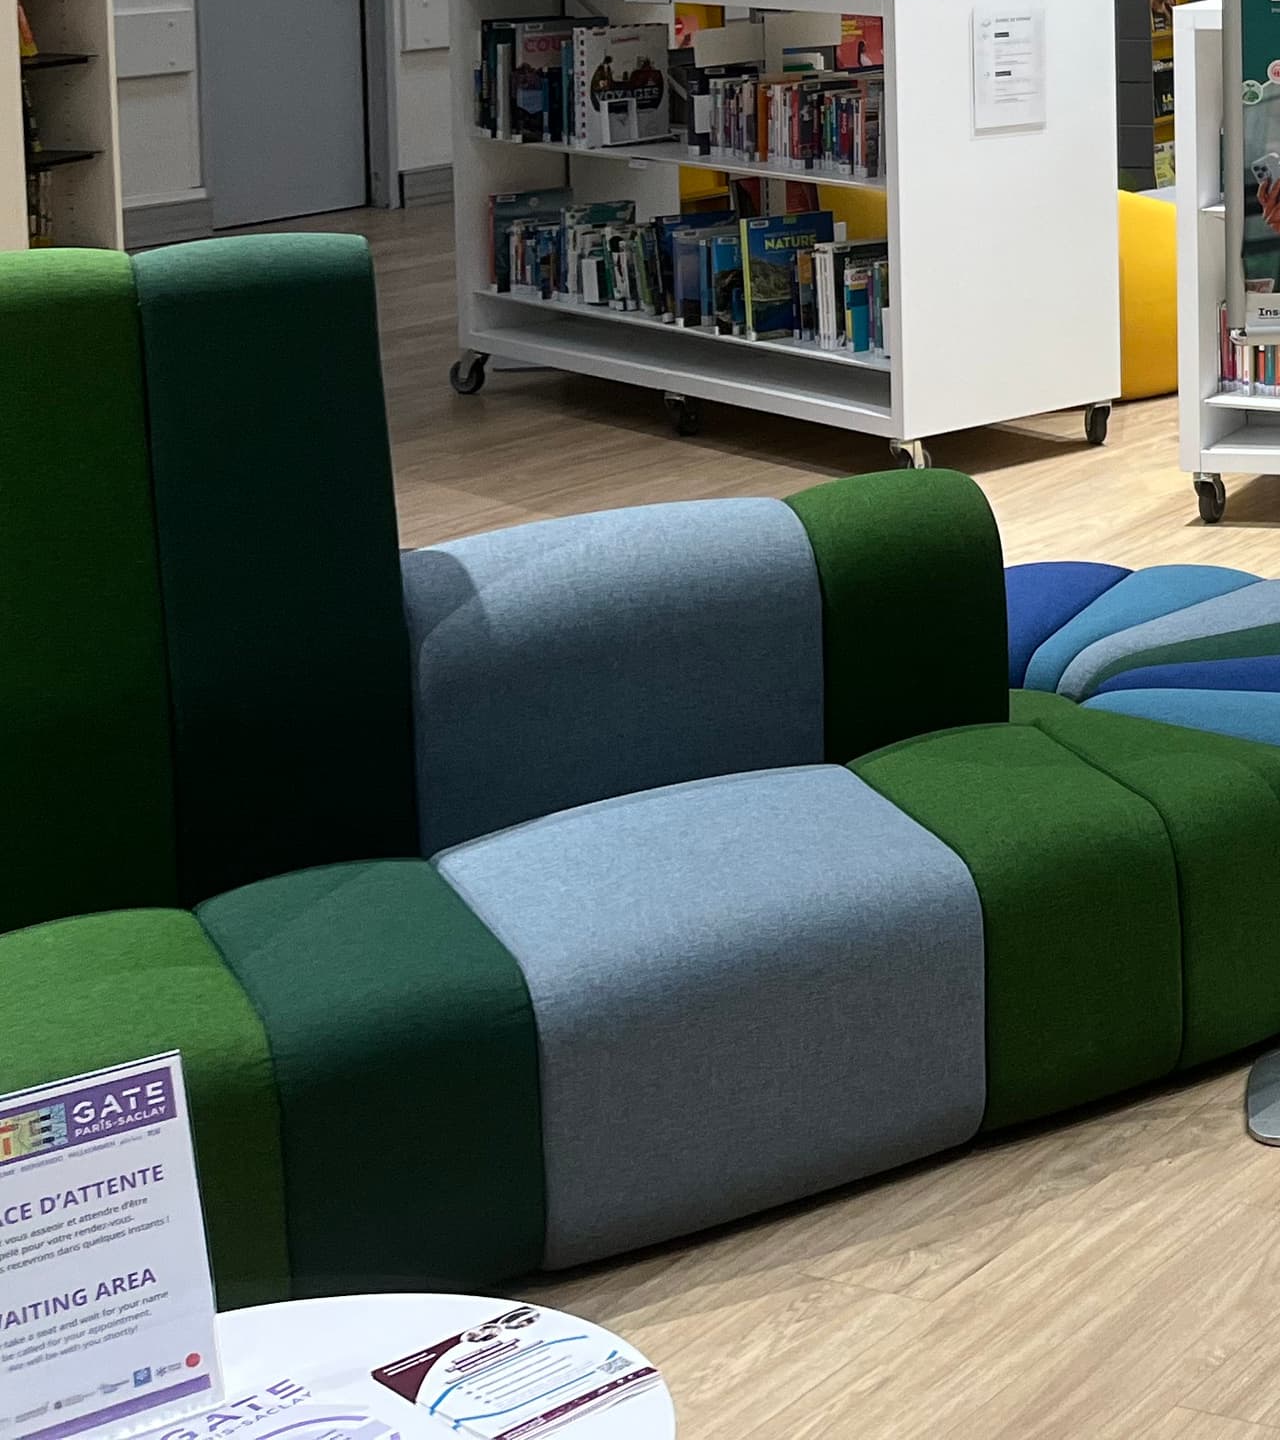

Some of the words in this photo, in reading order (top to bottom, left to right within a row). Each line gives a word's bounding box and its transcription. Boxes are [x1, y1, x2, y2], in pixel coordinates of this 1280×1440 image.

[765, 235, 816, 250] NATURE
[72, 1081, 166, 1124] GATE
[75, 1106, 166, 1137] PARIS-SACLAY
[40, 1164, 164, 1216] D'ATTENTE
[5, 1231, 28, 1245] vous
[30, 1222, 65, 1239] asseoir
[67, 1217, 77, 1227] et
[78, 1206, 119, 1224] attendre
[121, 1196, 149, 1211] d'être
[7, 1250, 55, 1271] recevrons
[56, 1243, 81, 1257] dans
[82, 1231, 127, 1250] quelques
[128, 1218, 165, 1235] instants
[21, 1241, 46, 1257] pour
[46, 1234, 72, 1247] votre
[95, 1268, 157, 1301] AREA
[3, 1335, 26, 1348] take
[28, 1333, 35, 1342] a
[36, 1325, 58, 1339] seat
[59, 1318, 79, 1332] and
[79, 1313, 100, 1325] wait
[102, 1306, 117, 1318] for
[117, 1299, 141, 1314] your
[141, 1291, 169, 1305] name
[16, 1341, 46, 1357] called
[47, 1335, 62, 1348] for
[63, 1329, 86, 1345] your
[82, 1338, 101, 1351] you
